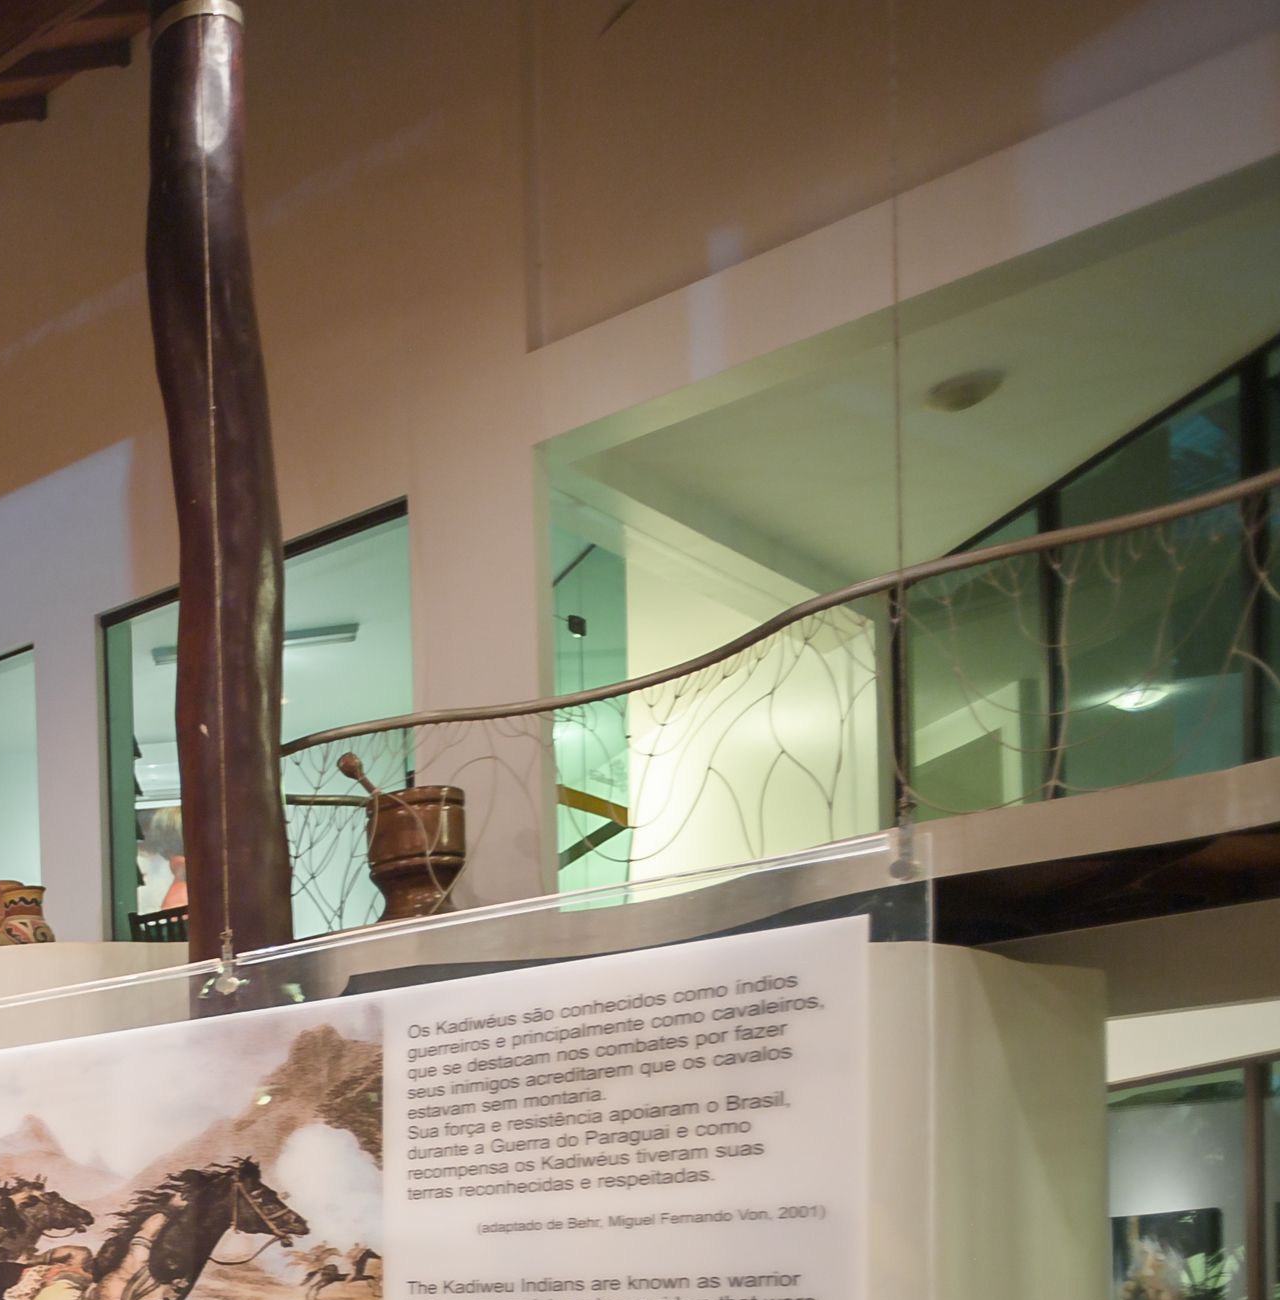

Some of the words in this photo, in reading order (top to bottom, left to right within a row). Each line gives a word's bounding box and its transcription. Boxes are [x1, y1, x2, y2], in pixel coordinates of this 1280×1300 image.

[408, 1025, 430, 1038] Os
[436, 1014, 517, 1034] Kadiwéus
[522, 1008, 554, 1023] são
[560, 994, 667, 1018] conhecidos
[673, 986, 728, 1003] como
[408, 1039, 490, 1063] guerreiros
[496, 1037, 506, 1048] e
[512, 1018, 644, 1047] principalmente
[651, 1012, 705, 1028] como
[408, 1066, 437, 1081] que
[443, 1064, 462, 1075] se
[467, 1053, 550, 1072] destacam
[557, 1048, 589, 1061] nos
[595, 1036, 688, 1057] combates
[695, 1031, 728, 1049] por
[734, 1024, 787, 1040] fazer
[408, 1086, 445, 1099] seus
[451, 1077, 520, 1094] inimigos
[526, 1065, 633, 1087] acreditarem
[640, 1060, 676, 1077] que
[683, 1057, 706, 1070] os
[713, 1046, 793, 1066] cavalos
[408, 1103, 476, 1119] estavam
[482, 1099, 517, 1112] sem
[524, 1088, 606, 1107] montaria.
[408, 1126, 439, 1139] Sua
[444, 1122, 485, 1138] força
[491, 1121, 501, 1132] e
[507, 1110, 602, 1130] resistência
[609, 1103, 699, 1124] apoiaram
[706, 1101, 719, 1113] o
[726, 1091, 790, 1111] Brasil,
[408, 1144, 469, 1160] durante
[474, 1144, 484, 1154] a
[491, 1138, 550, 1153] Guerra
[556, 1134, 579, 1148] do
[585, 1125, 669, 1146] Paraguai
[676, 1127, 688, 1138] e
[695, 1121, 751, 1136] como
[408, 1163, 509, 1180] recompensa
[515, 1161, 535, 1172] os
[541, 1152, 630, 1170] Kadiwéus
[636, 1148, 708, 1163] tiveram
[715, 1143, 764, 1158] suas
[408, 1187, 453, 1200] terras
[459, 1178, 574, 1196] reconhecidas
[580, 1178, 591, 1189] e
[598, 1168, 715, 1189] respeitadas.
[546, 1218, 563, 1230] de
[608, 1214, 656, 1229] Miguel
[660, 1211, 733, 1224] Fernando
[778, 1205, 826, 1219] 2001)
[407, 1281, 437, 1294] The
[443, 1280, 514, 1294] Kadiweu
[521, 1278, 585, 1292] Indians
[591, 1279, 621, 1291] are
[628, 1276, 690, 1289] known
[697, 1277, 721, 1288] as
[727, 1272, 801, 1287] warrior
